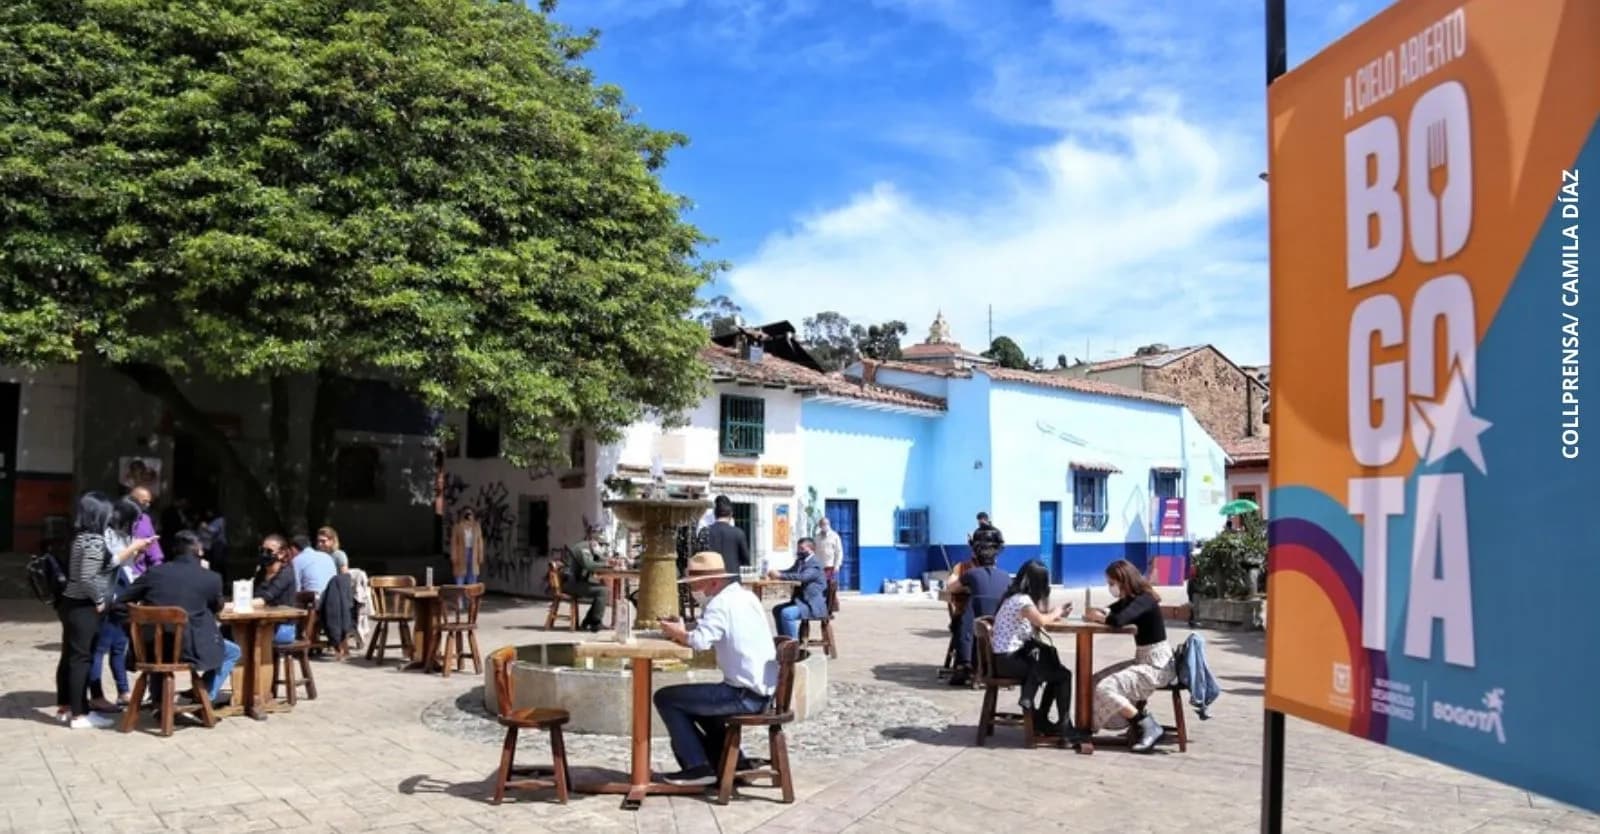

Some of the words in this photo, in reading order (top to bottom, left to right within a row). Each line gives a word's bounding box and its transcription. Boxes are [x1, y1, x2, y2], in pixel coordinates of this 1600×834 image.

[1344, 75, 1354, 120] A
[1356, 50, 1396, 112] CIELO
[1400, 6, 1466, 89] ABIERTO
[1348, 472, 1475, 668] TA
